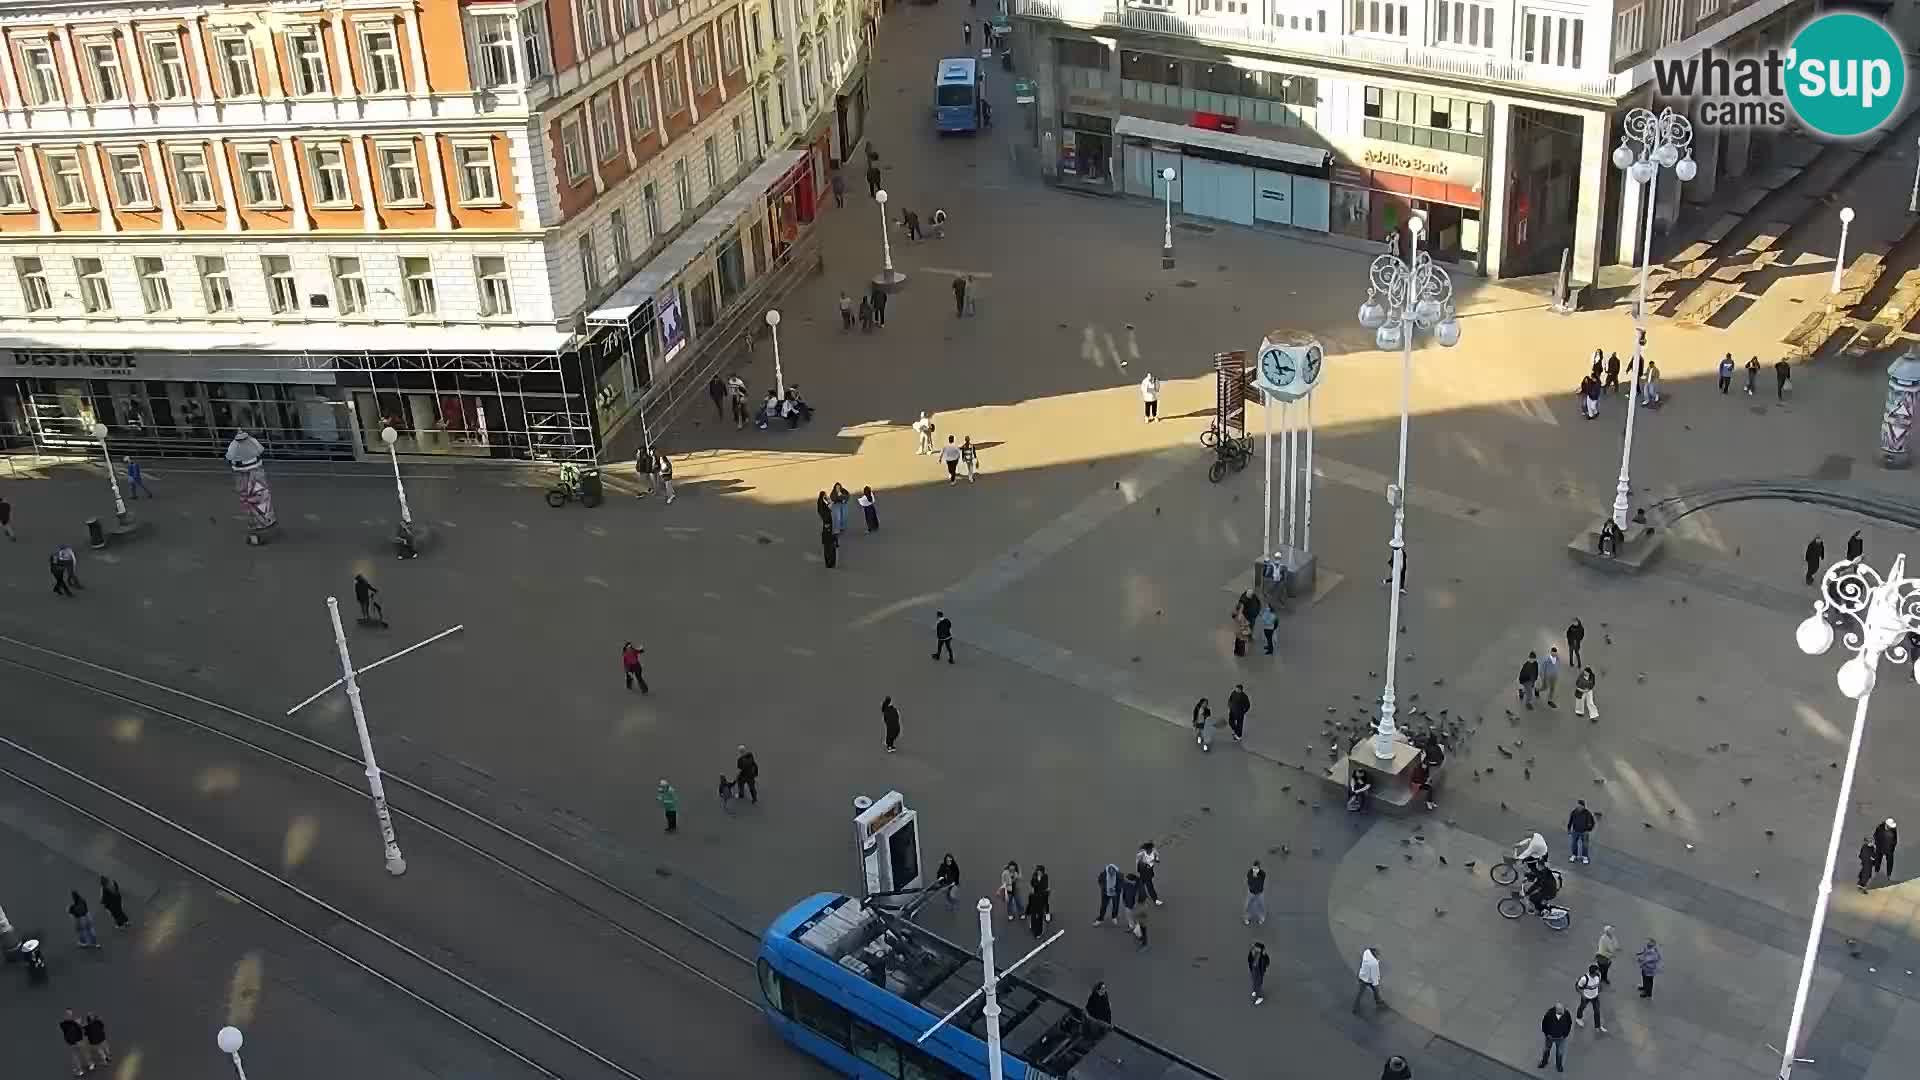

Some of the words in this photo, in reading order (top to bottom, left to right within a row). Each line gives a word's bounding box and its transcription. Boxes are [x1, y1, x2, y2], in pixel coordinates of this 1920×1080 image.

[1364, 150, 1411, 169] Addiko
[1413, 159, 1449, 176] Bank
[13, 351, 137, 368] DESSANGE
